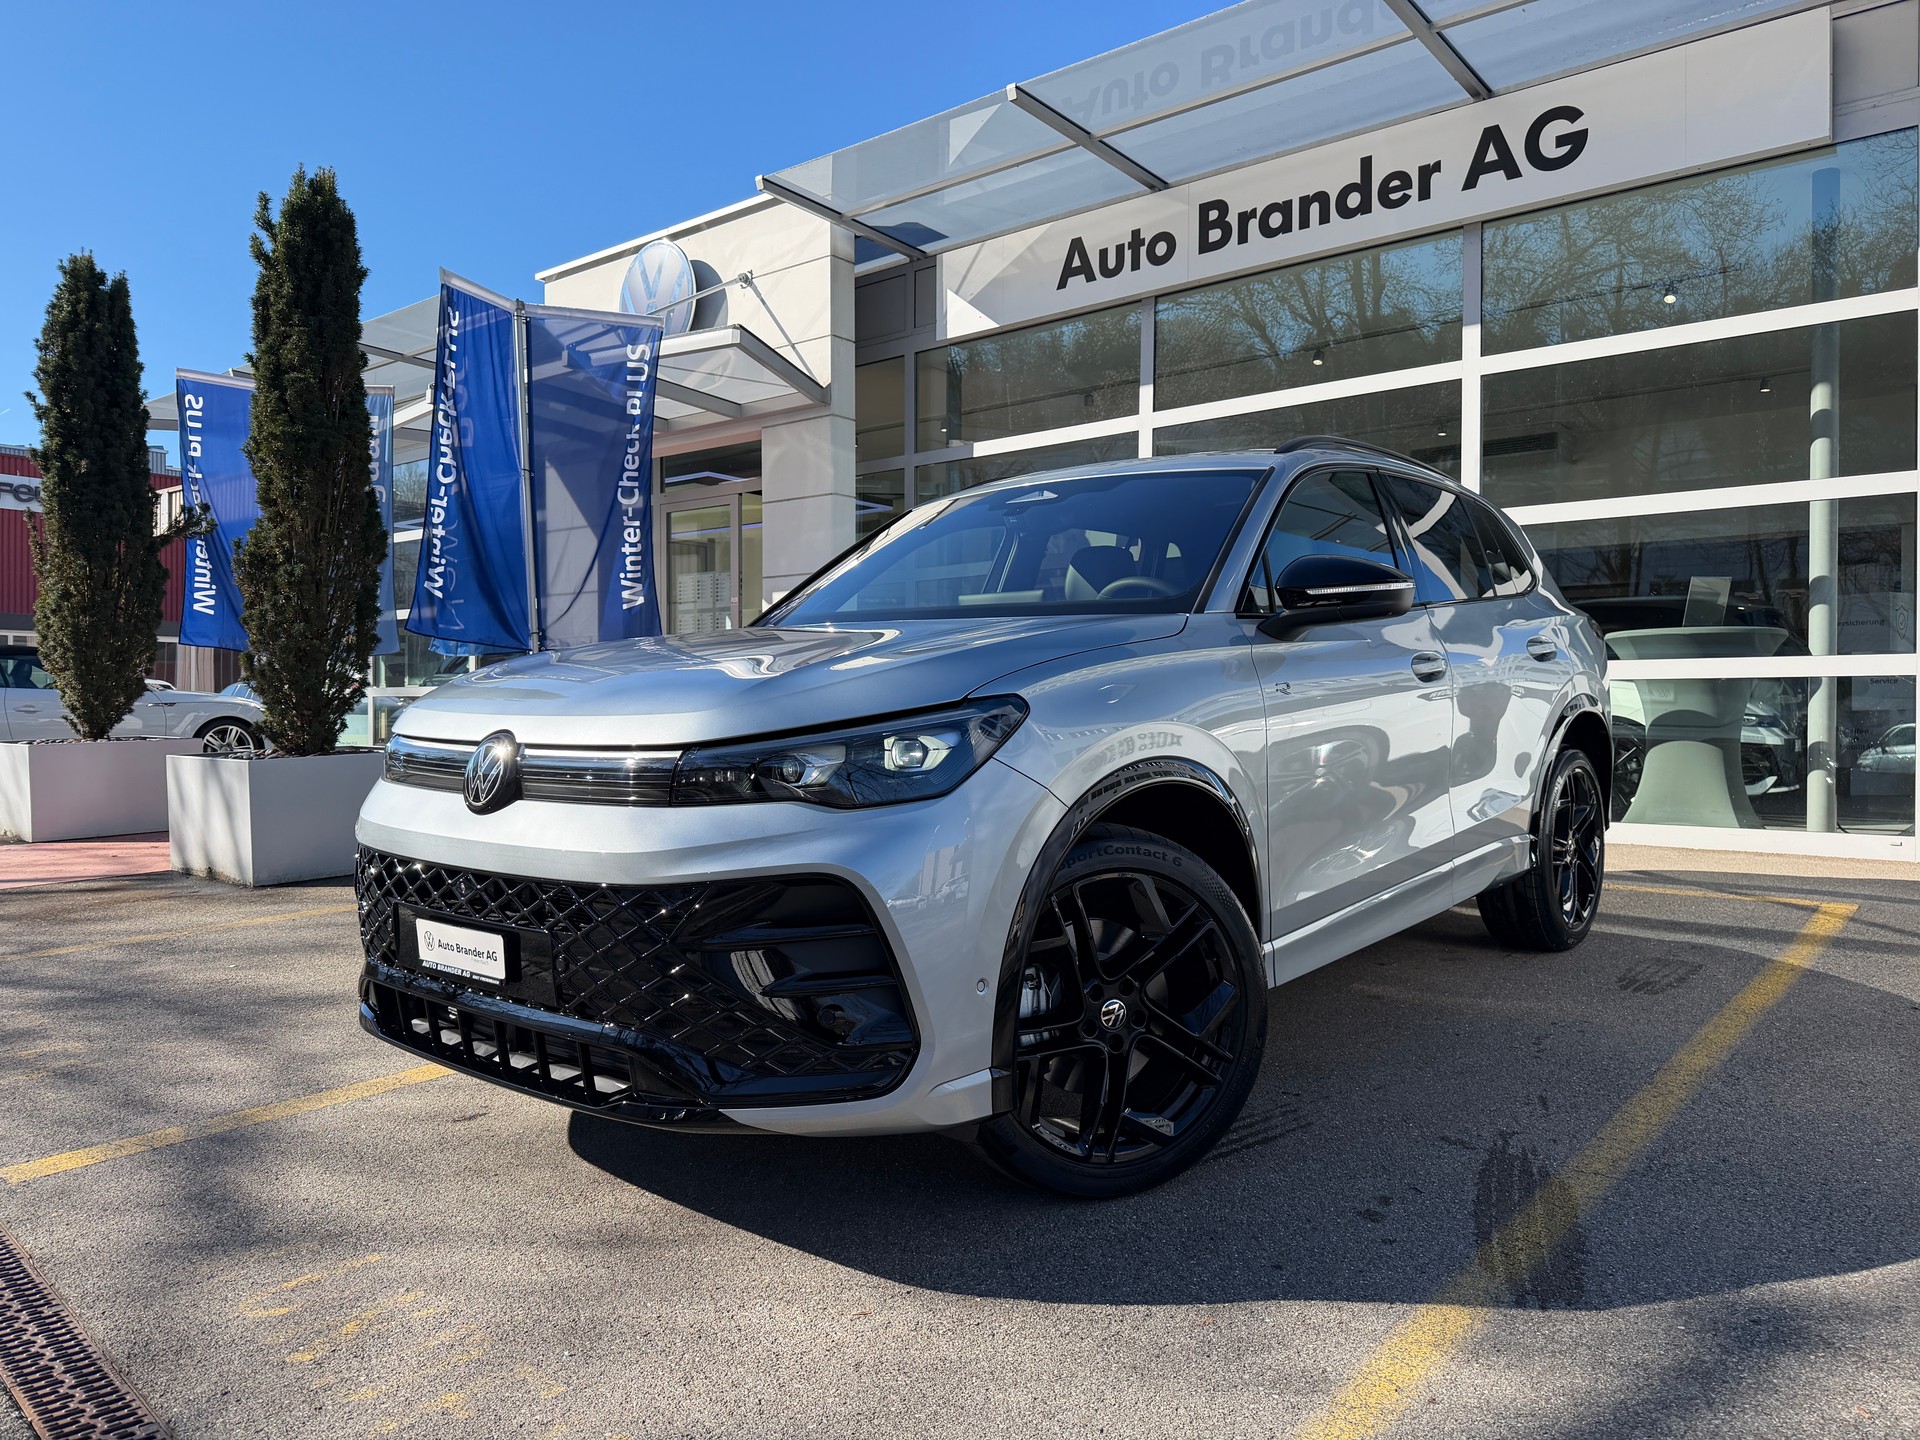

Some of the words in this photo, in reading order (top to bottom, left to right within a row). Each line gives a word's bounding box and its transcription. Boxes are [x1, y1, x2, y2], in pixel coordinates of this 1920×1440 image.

[1057, 228, 1177, 291] Auto
[1198, 155, 1442, 255] Brander
[1461, 106, 1590, 191] AG
[617, 424, 645, 610] Winter-Check
[1172, 856, 1183, 867] 6
[438, 939, 455, 952] Auto
[456, 943, 485, 959] Brander
[486, 950, 498, 962] AG
[422, 960, 437, 969] AUTO
[437, 964, 461, 976] BRANDER
[462, 970, 471, 978] AG
